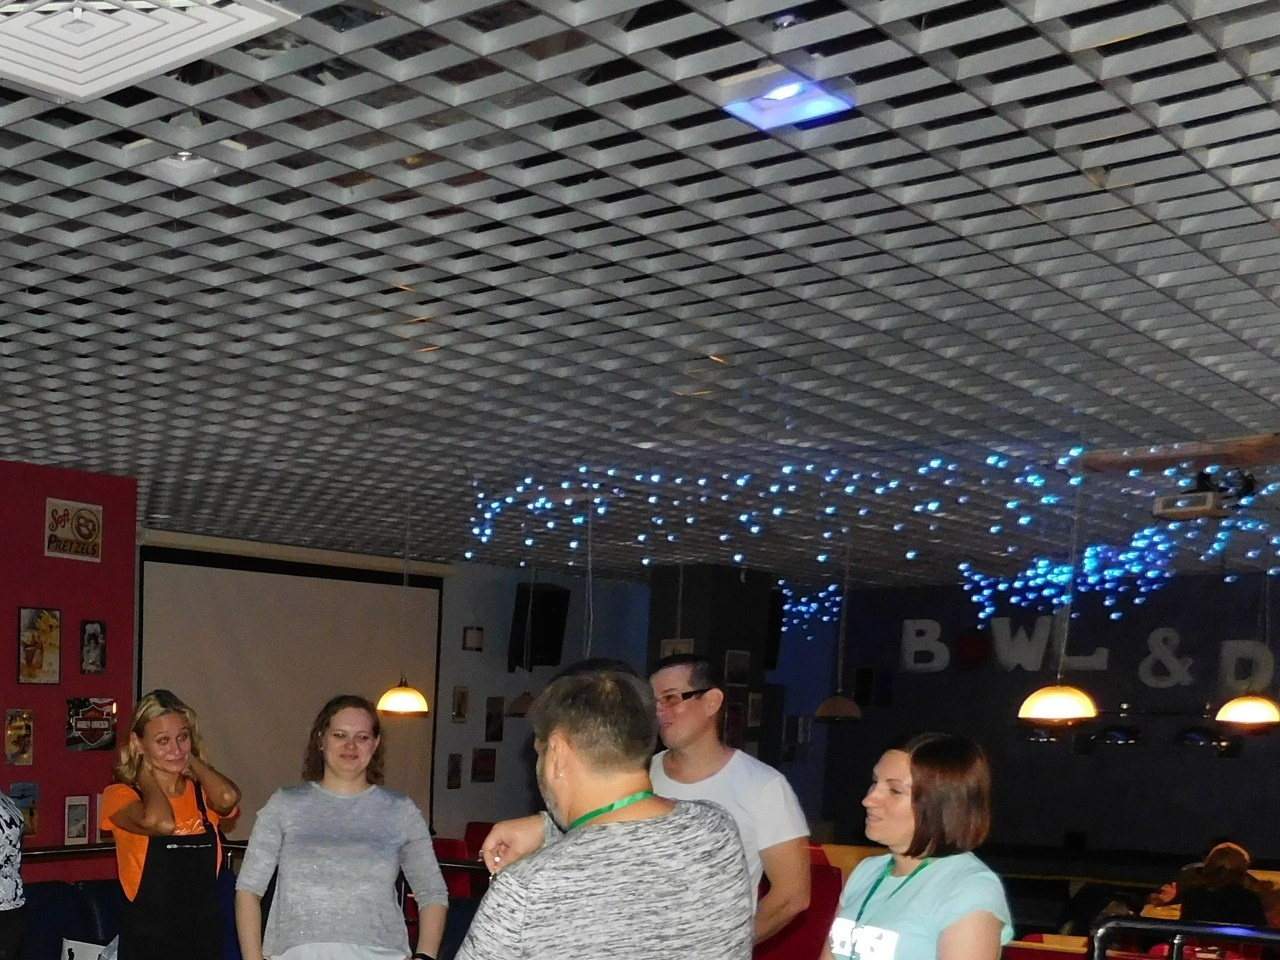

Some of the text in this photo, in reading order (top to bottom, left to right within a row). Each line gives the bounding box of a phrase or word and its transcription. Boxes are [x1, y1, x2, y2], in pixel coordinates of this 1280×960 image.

[48, 508, 70, 532] Soft
[47, 534, 97, 556] PRETZELS
[1138, 626, 1194, 689] &
